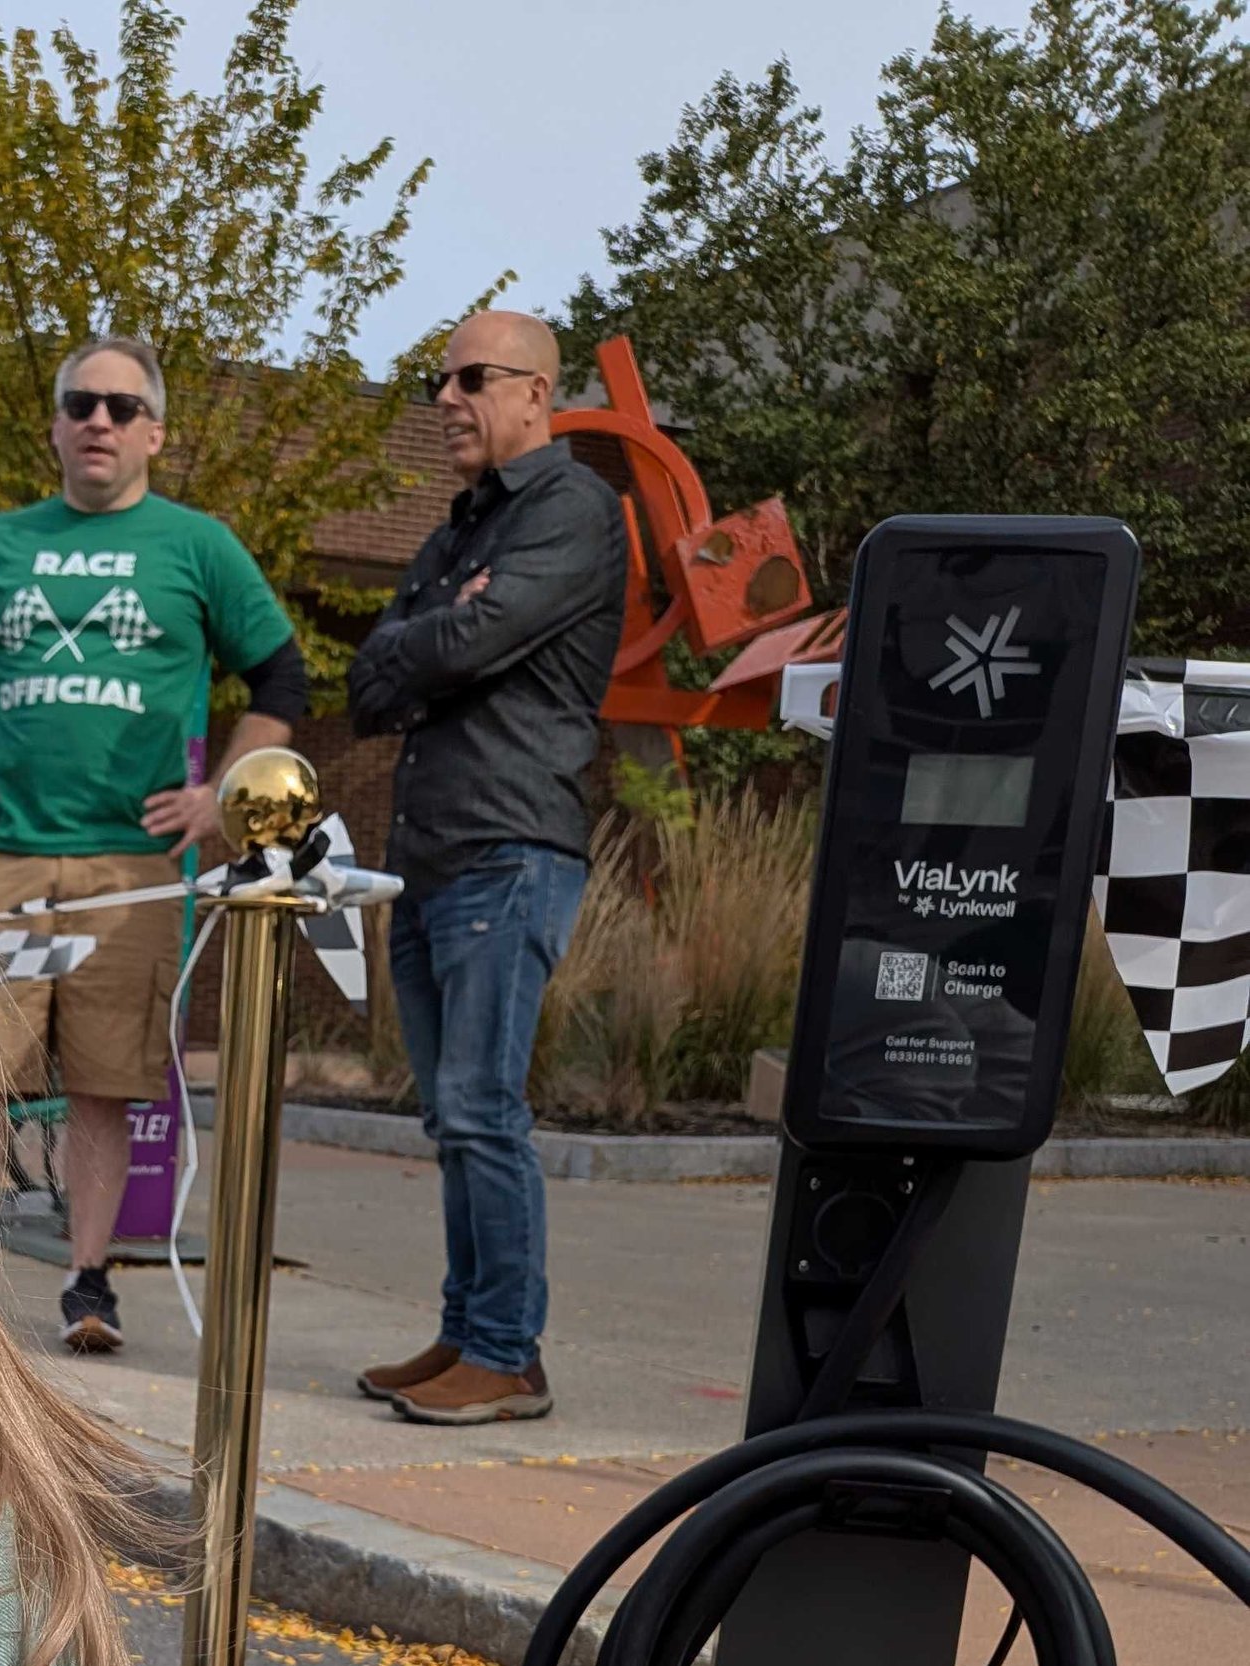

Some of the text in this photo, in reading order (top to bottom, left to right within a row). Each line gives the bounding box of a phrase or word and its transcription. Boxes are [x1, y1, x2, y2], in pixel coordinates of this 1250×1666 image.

[32, 551, 137, 577] RACE
[0, 674, 146, 714] OFFICIAL
[893, 860, 1020, 897] ViaLynk
[939, 898, 1017, 918] Lynkwell
[947, 961, 1007, 978] Scan to
[944, 980, 1003, 999] Charge
[885, 1034, 976, 1051] Call for Support
